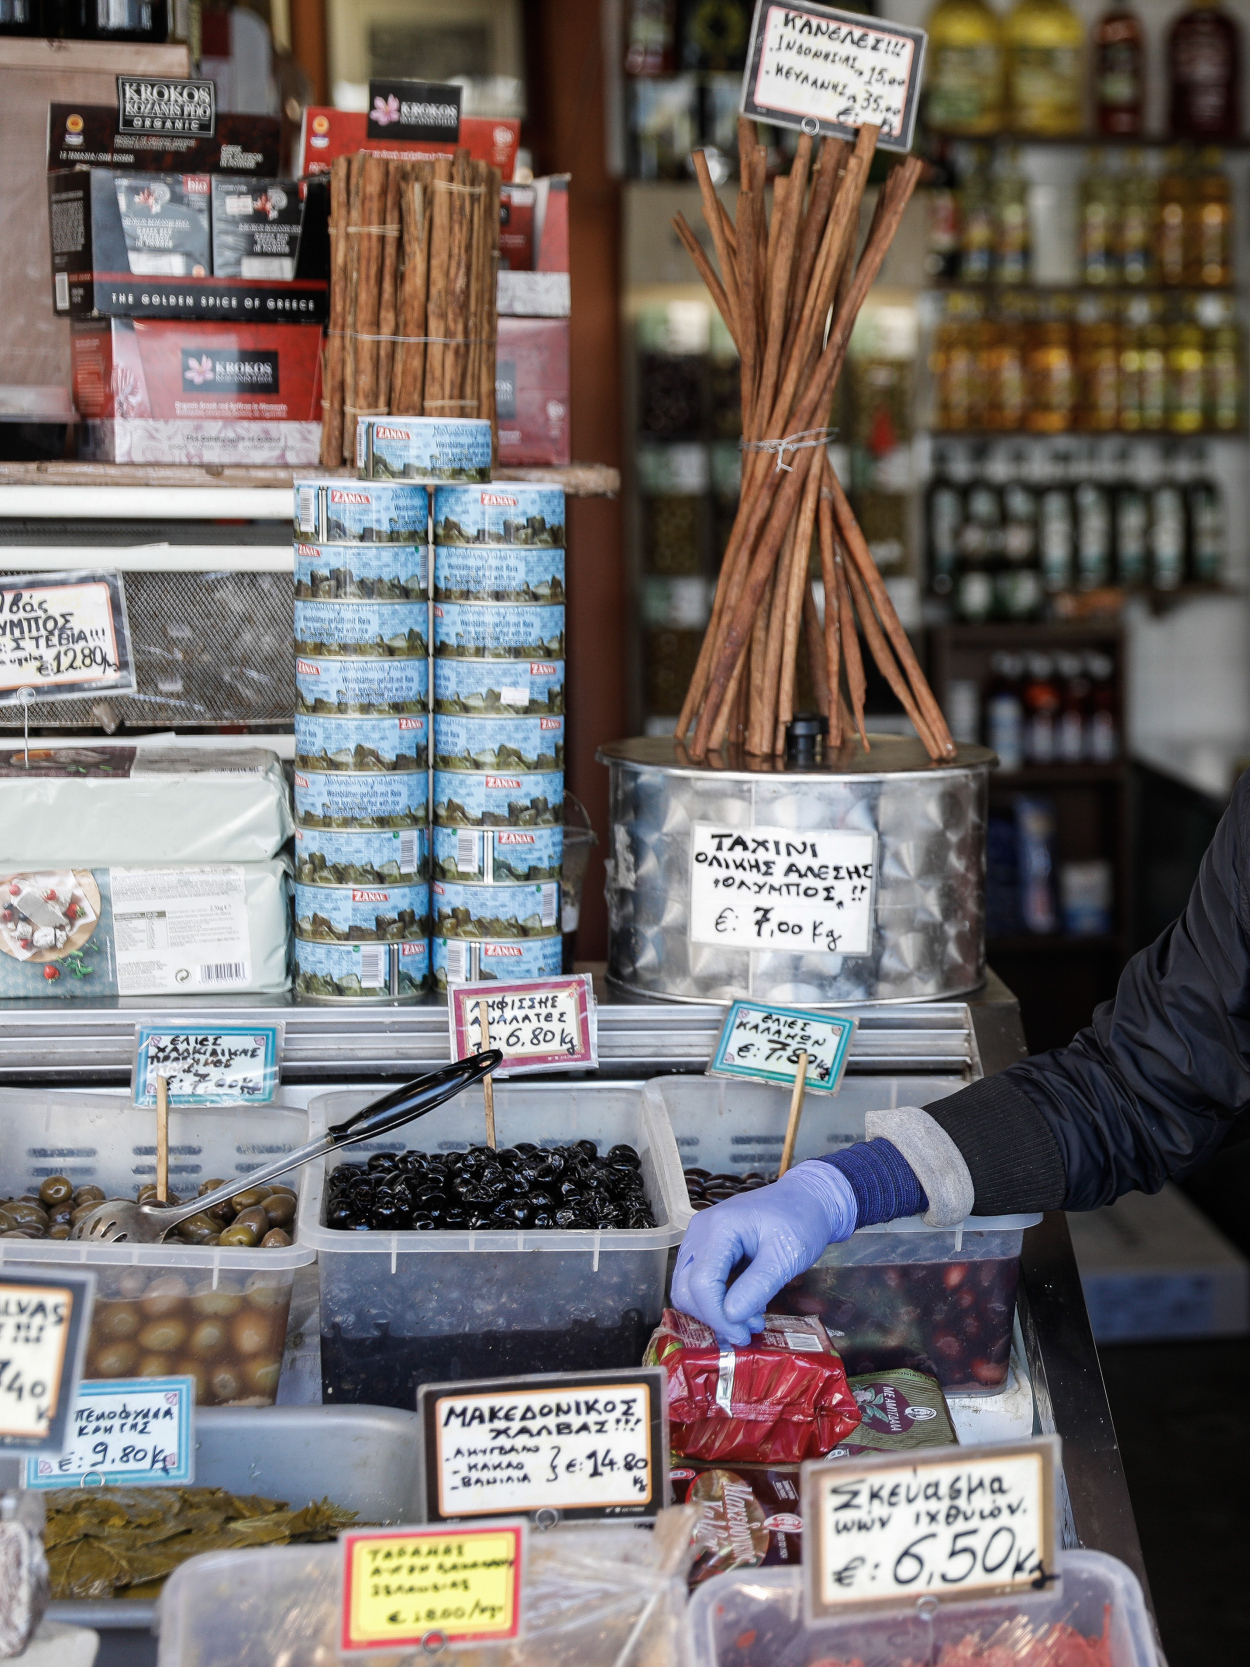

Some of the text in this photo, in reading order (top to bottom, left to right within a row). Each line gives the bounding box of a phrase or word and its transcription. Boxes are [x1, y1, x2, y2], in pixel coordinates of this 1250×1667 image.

[124, 83, 210, 106] KROKOS
[125, 100, 211, 120] KOZANIS PDO
[132, 117, 200, 131] ORGANIC
[111, 292, 315, 311] THE GOLDEN SPICE OF GREECE
[215, 361, 273, 374] KROKOS
[332, 490, 369, 504] ZANAE
[711, 833, 818, 858] ΤΑΧΙΝΙ
[694, 852, 873, 881] ΟΛΙΚΗΣ ΑΛΕΣΗΣ
[354, 890, 387, 901] ZANAE
[753, 906, 803, 937] 7,00
[486, 946, 521, 956] ZANAE
[169, 1035, 222, 1047] ΕΛΙΕΣ
[506, 1026, 555, 1048] 6,80
[443, 1397, 638, 1428] ΜΑΚΕΔΟΝΙΚΟΣ
[585, 1448, 649, 1479] 14.80
[830, 1466, 1012, 1512] Σκεύασμα
[893, 1526, 1016, 1587] 6,50
